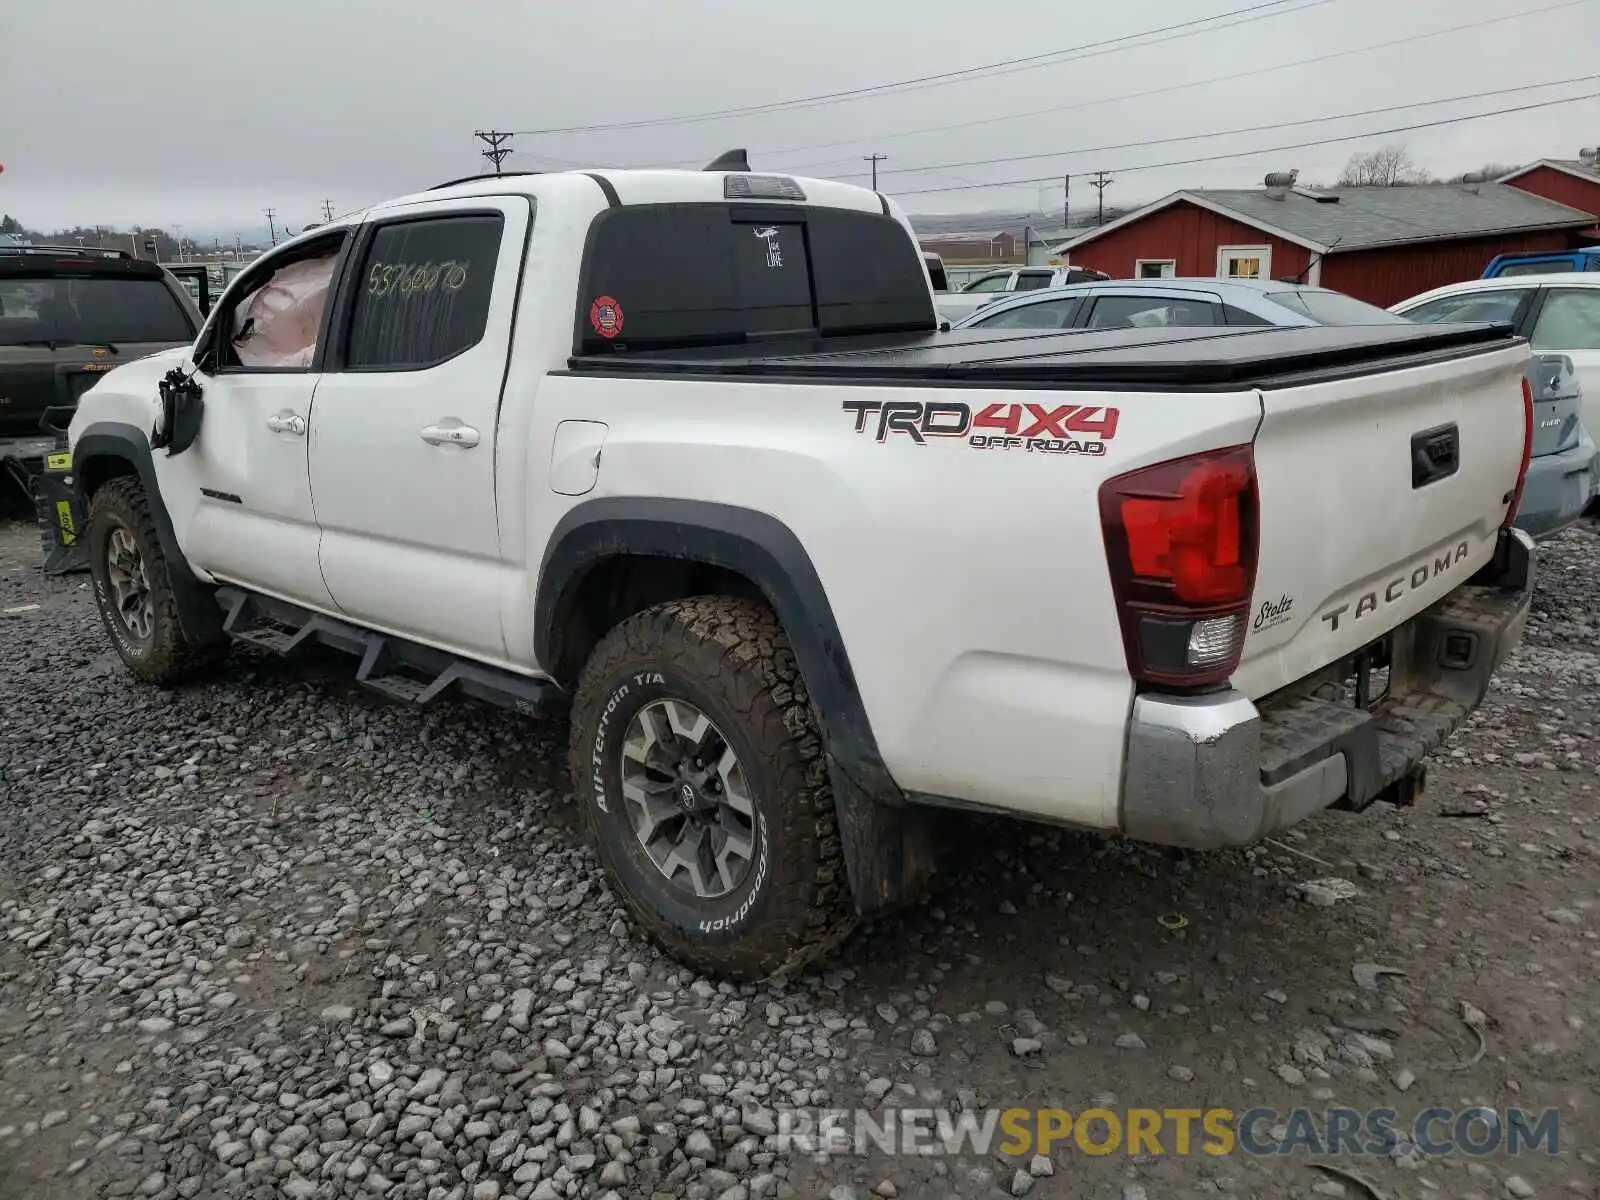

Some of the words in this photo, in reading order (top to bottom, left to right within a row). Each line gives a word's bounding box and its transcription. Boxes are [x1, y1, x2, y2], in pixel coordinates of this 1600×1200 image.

[842, 400, 972, 446] TRD
[969, 435, 1023, 451] OFF
[1025, 437, 1107, 456] ROAD
[1321, 541, 1469, 631] TACOMA
[1253, 594, 1293, 628] Stoltz
[633, 672, 666, 686] T/A
